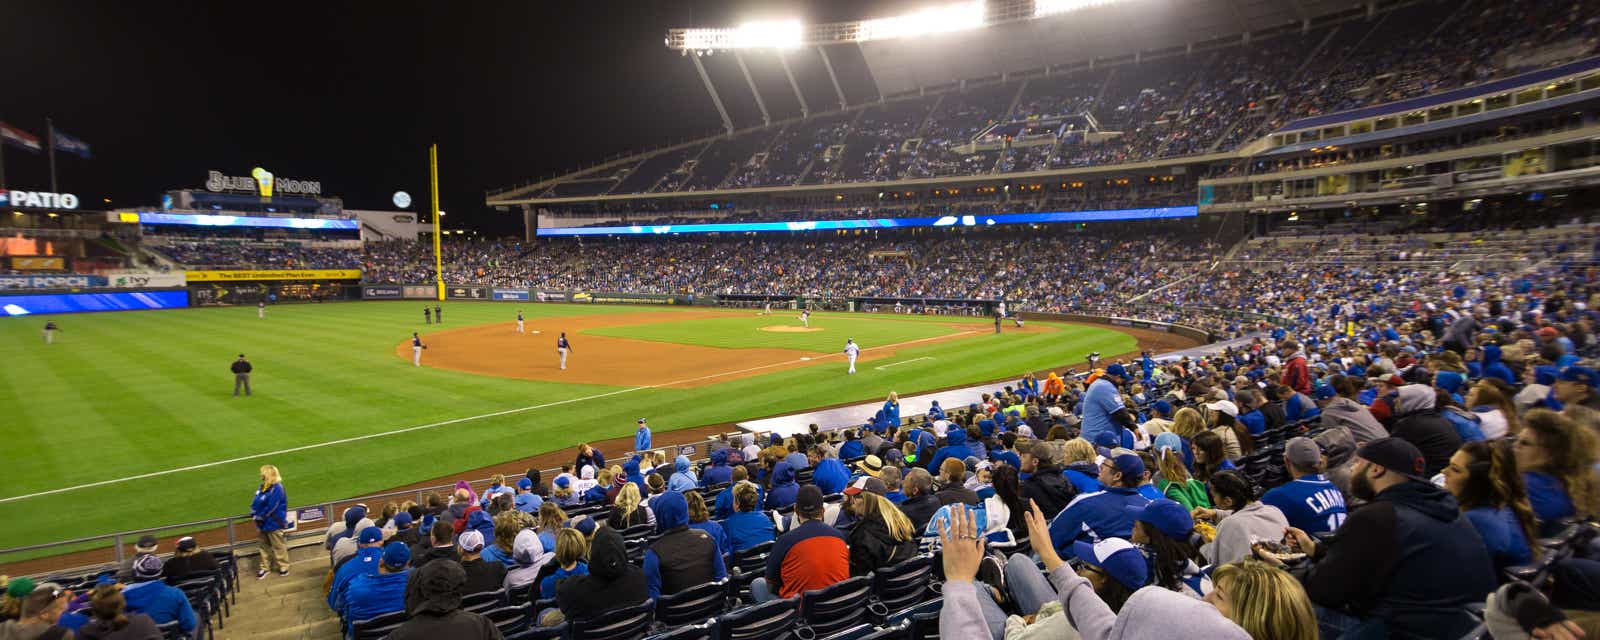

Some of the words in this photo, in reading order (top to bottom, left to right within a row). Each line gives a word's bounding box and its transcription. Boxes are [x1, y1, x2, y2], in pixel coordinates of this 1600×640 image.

[276, 177, 321, 194] MOON
[9, 190, 79, 209] PATIO
[0, 277, 29, 288] EPSI
[33, 277, 88, 289] PORCH
